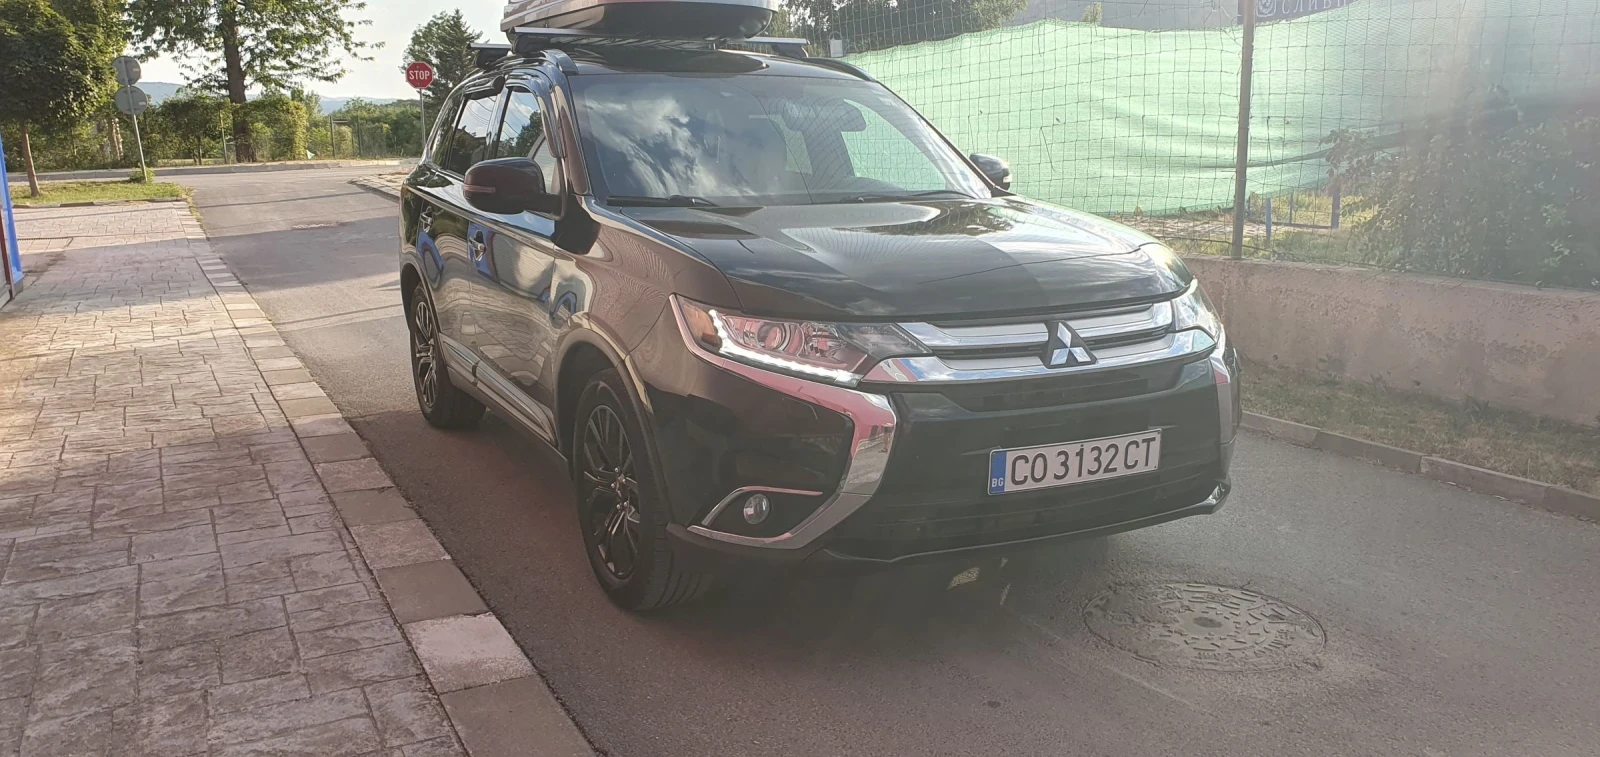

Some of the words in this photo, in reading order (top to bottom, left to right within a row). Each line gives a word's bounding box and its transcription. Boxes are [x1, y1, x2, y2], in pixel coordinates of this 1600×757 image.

[409, 70, 430, 80] STOP
[1053, 443, 1120, 480] 3132
[991, 477, 1004, 488] BG
